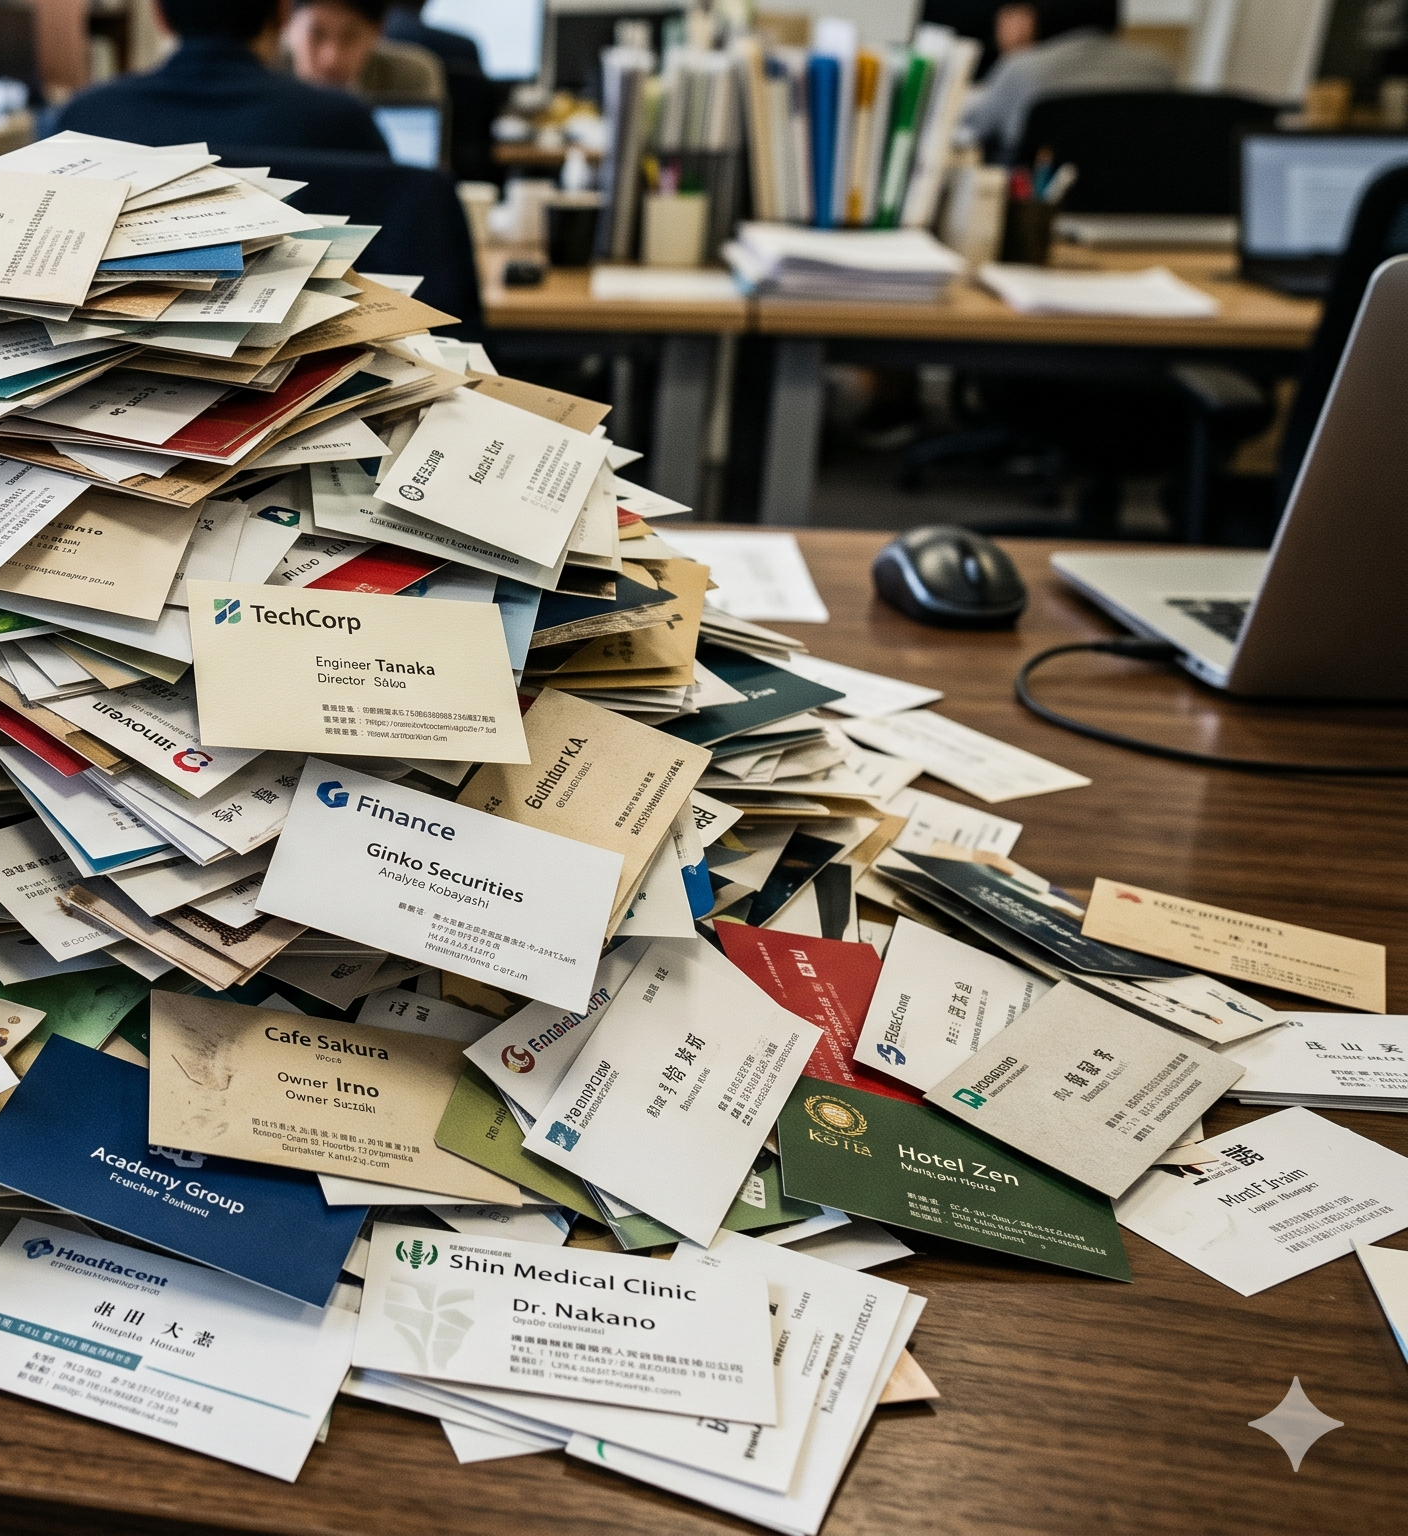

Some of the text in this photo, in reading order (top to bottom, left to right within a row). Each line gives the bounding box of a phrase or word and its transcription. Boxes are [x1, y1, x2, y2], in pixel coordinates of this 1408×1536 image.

[249, 604, 361, 635] TechCorp
[315, 655, 436, 676] Engineer Tanaka
[317, 673, 366, 686] Director
[356, 795, 456, 841] Finance
[366, 843, 524, 904] Ginko Securities
[428, 882, 490, 909] Kobayashi
[264, 1026, 390, 1061] Cafe Sakura
[277, 1071, 380, 1098] Owner Irno
[285, 1089, 329, 1105] Owner
[90, 1146, 182, 1191] Academy
[185, 1181, 245, 1215] Group
[898, 1143, 964, 1173] Hotel
[971, 1161, 1020, 1187] Zen
[449, 1254, 697, 1302] Shin Medical Clinic
[512, 1298, 546, 1316] Dr.
[555, 1303, 656, 1331] Nakano
